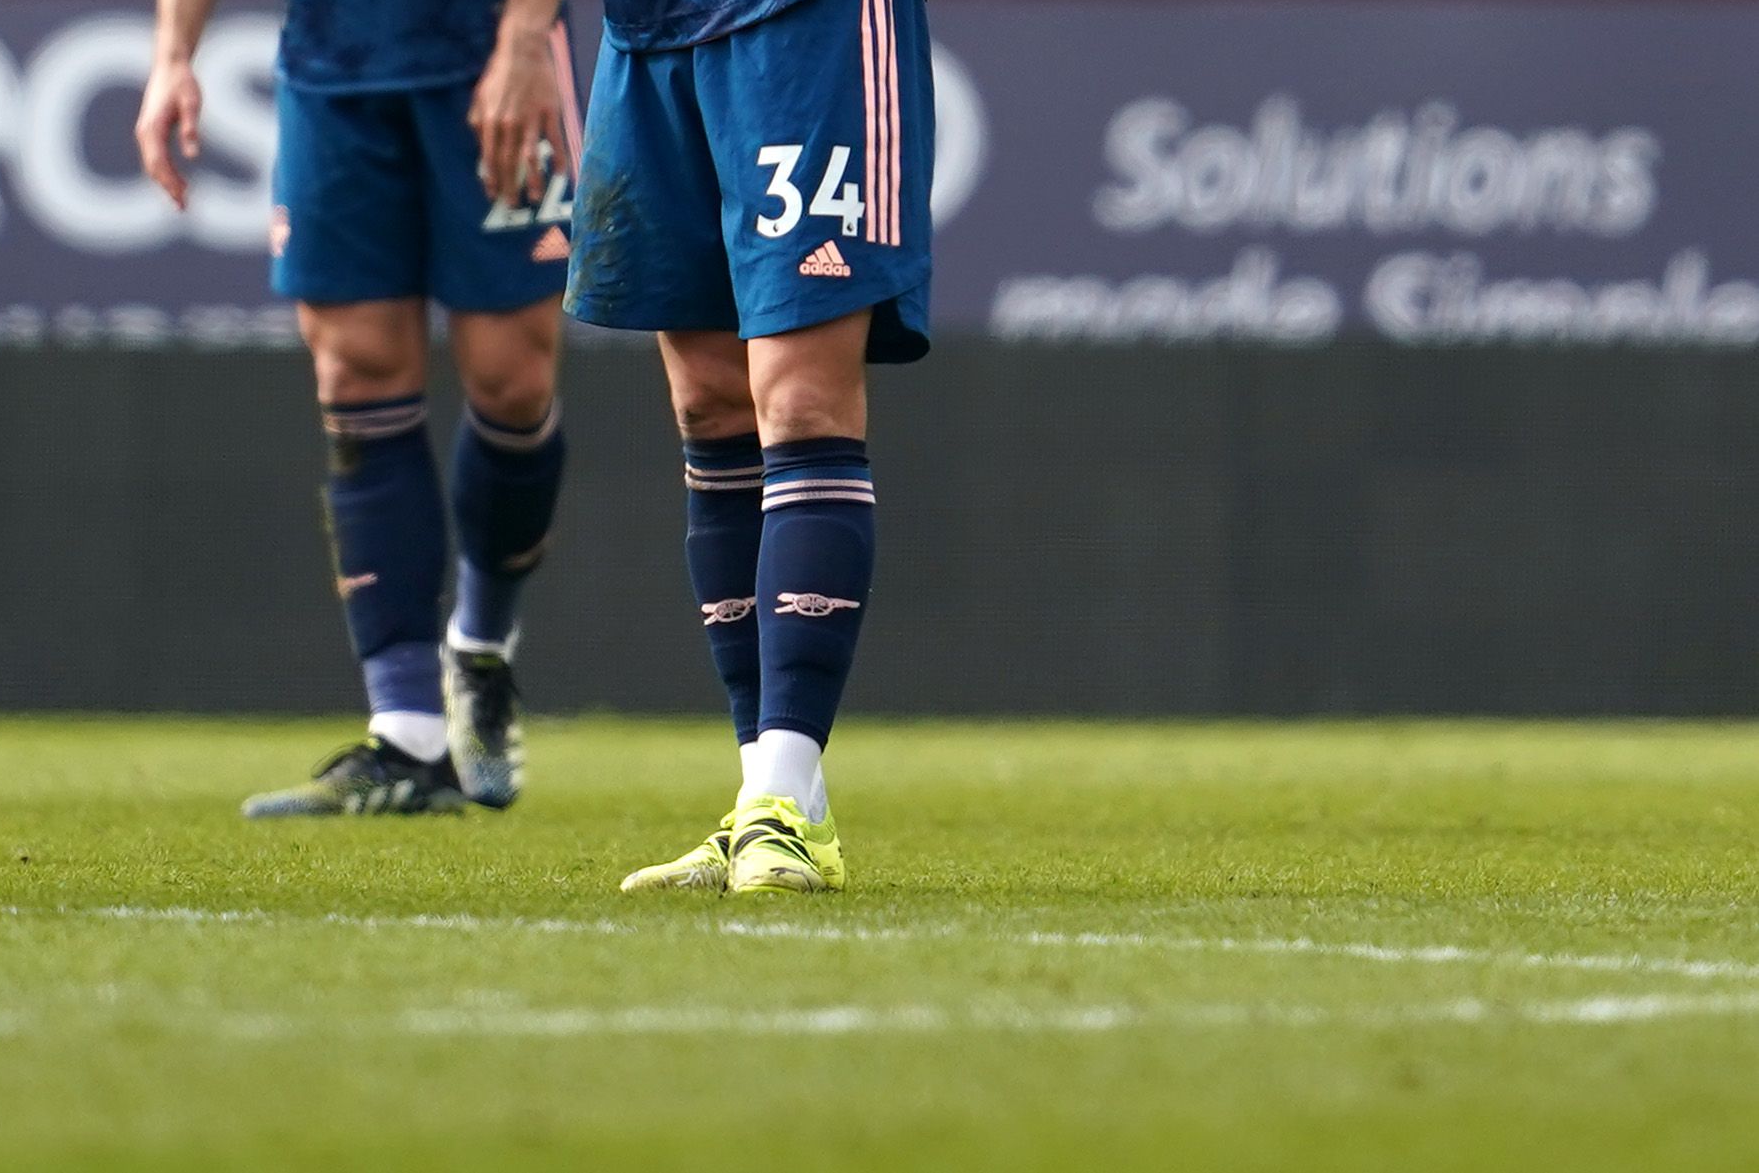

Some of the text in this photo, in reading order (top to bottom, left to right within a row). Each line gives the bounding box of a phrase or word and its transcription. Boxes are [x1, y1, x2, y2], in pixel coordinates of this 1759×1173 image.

[756, 144, 866, 239] 34
[1094, 93, 1662, 240] Solutions
[798, 261, 851, 278] adidas
